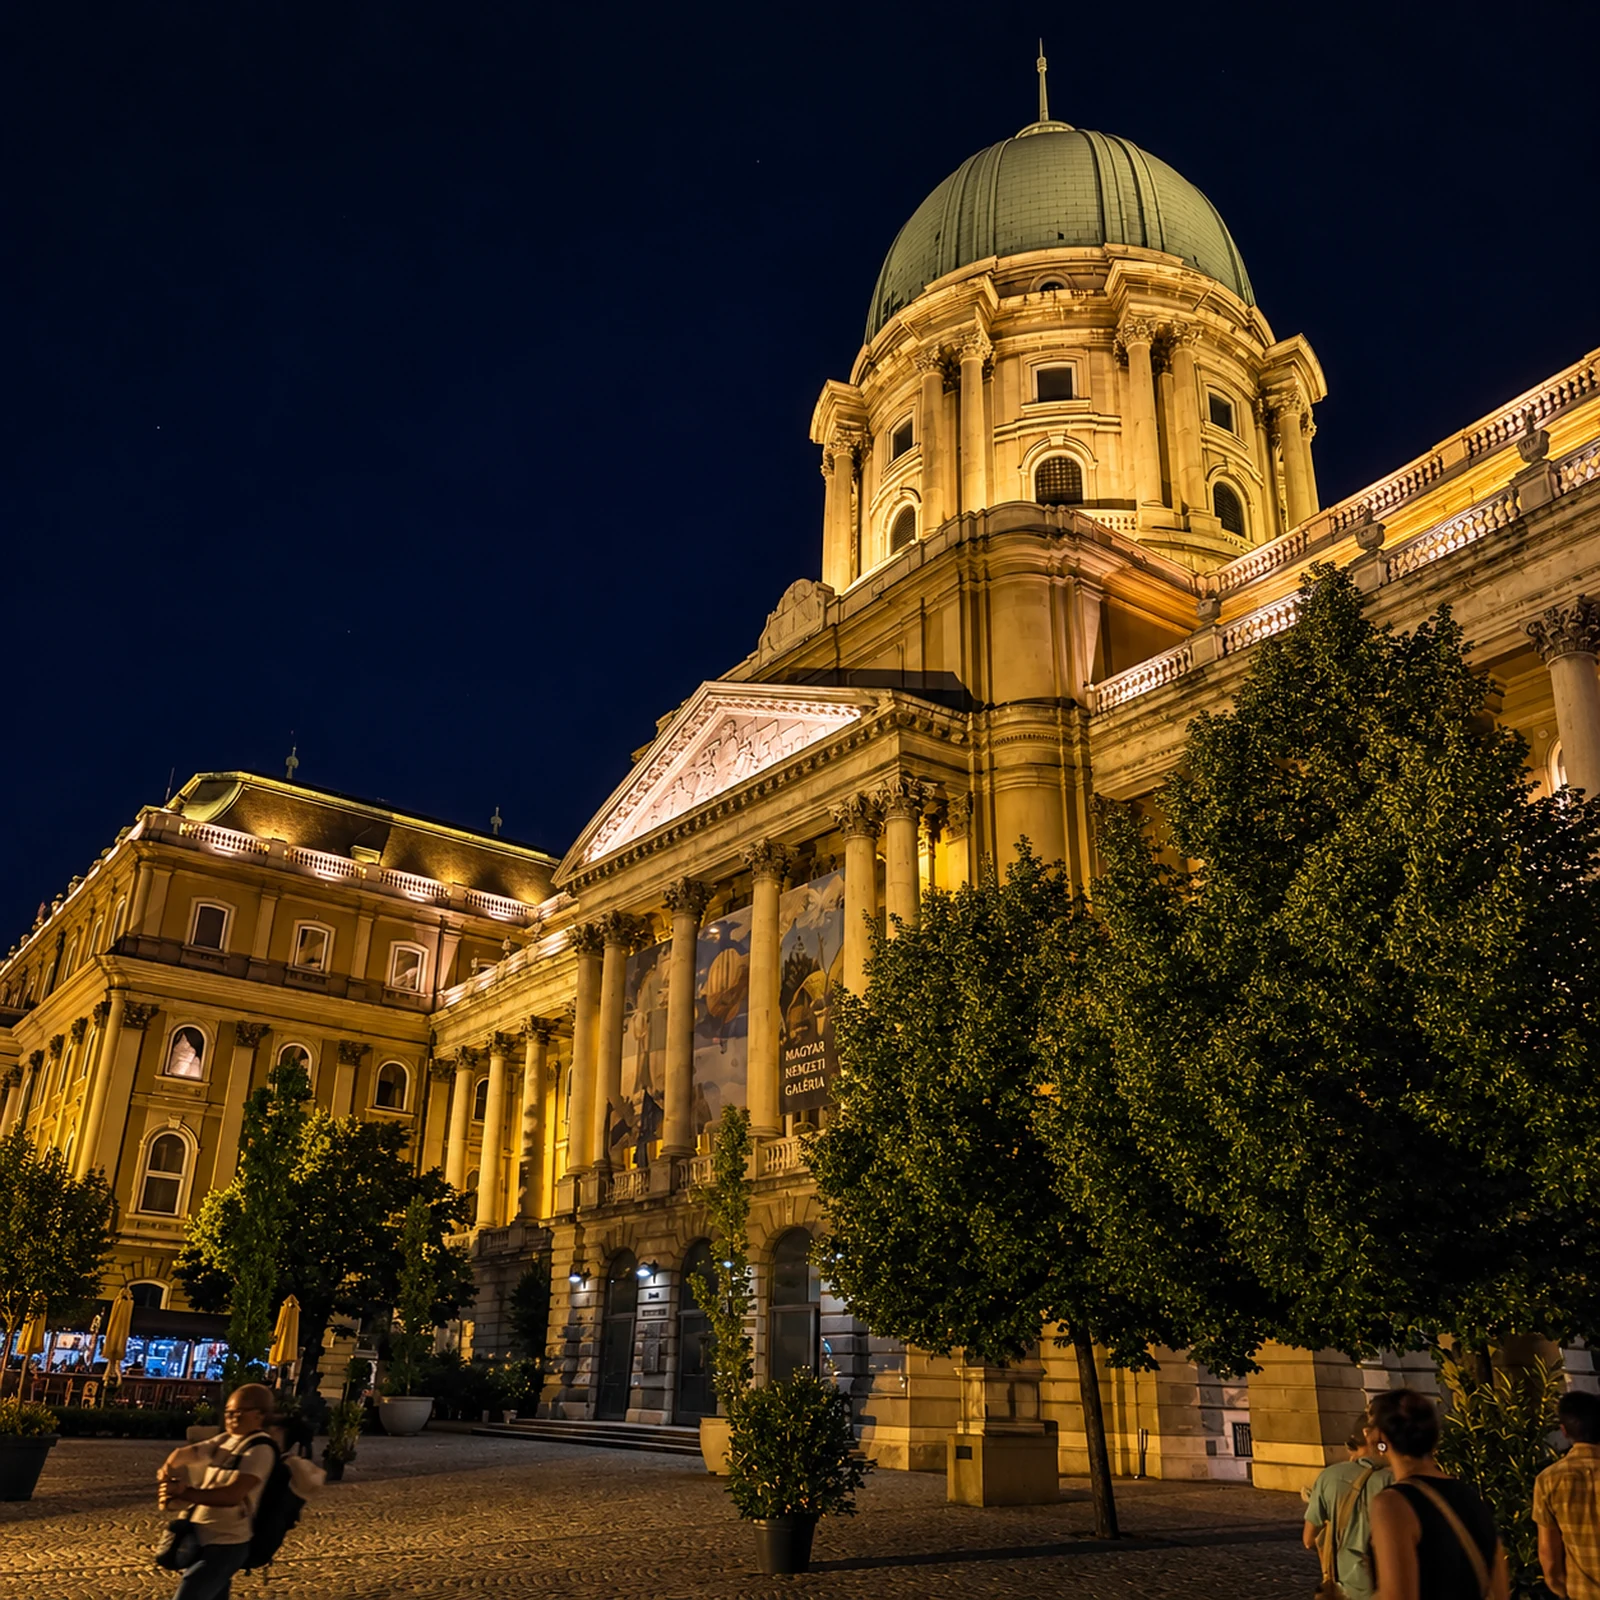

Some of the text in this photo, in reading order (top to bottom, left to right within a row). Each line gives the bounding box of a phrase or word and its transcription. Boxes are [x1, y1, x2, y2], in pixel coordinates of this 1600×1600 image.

[785, 1041, 825, 1061] MAGYAR
[785, 1058, 825, 1079] NEMZETI
[785, 1076, 825, 1096] GALÉRIA
